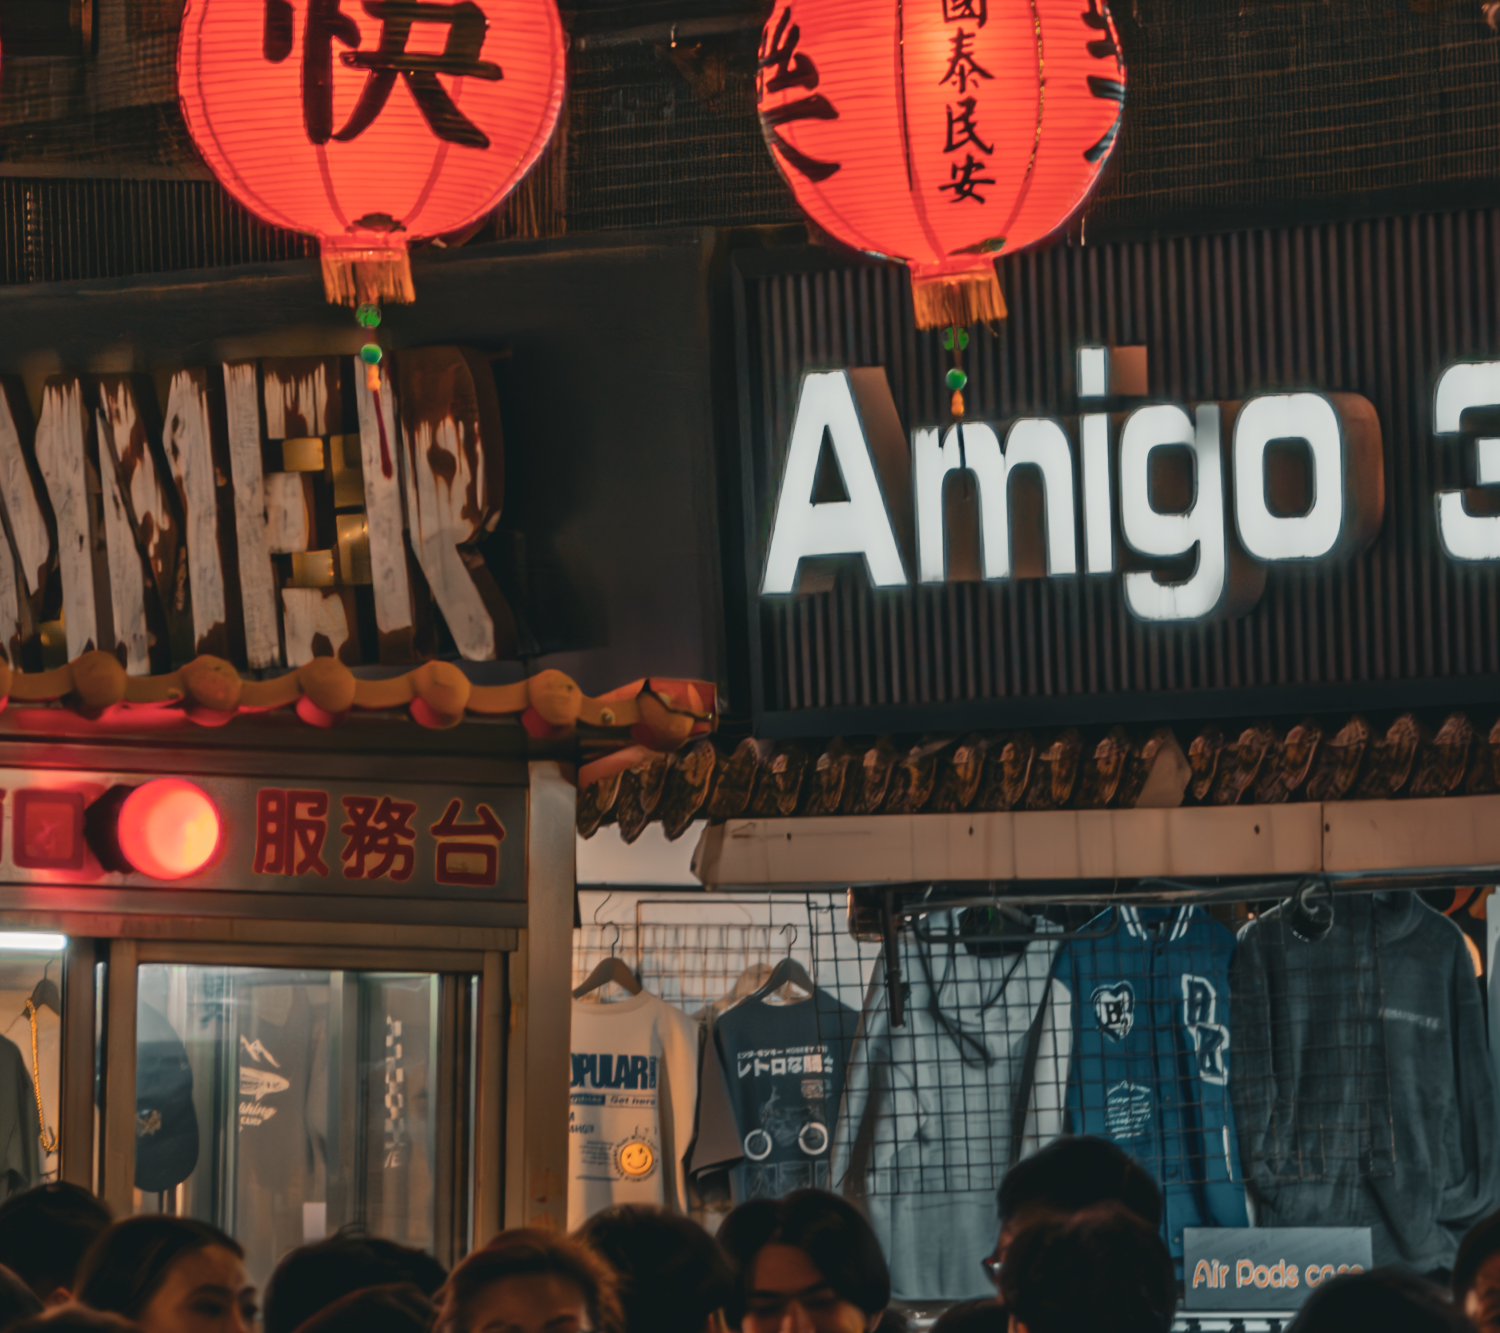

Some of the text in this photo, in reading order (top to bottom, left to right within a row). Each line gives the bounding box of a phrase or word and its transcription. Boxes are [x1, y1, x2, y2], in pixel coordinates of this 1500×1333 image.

[762, 345, 1345, 623] Amigo
[251, 786, 507, 891] 服務台
[1192, 1258, 1229, 1289] Air
[1236, 1258, 1300, 1289] Pods
